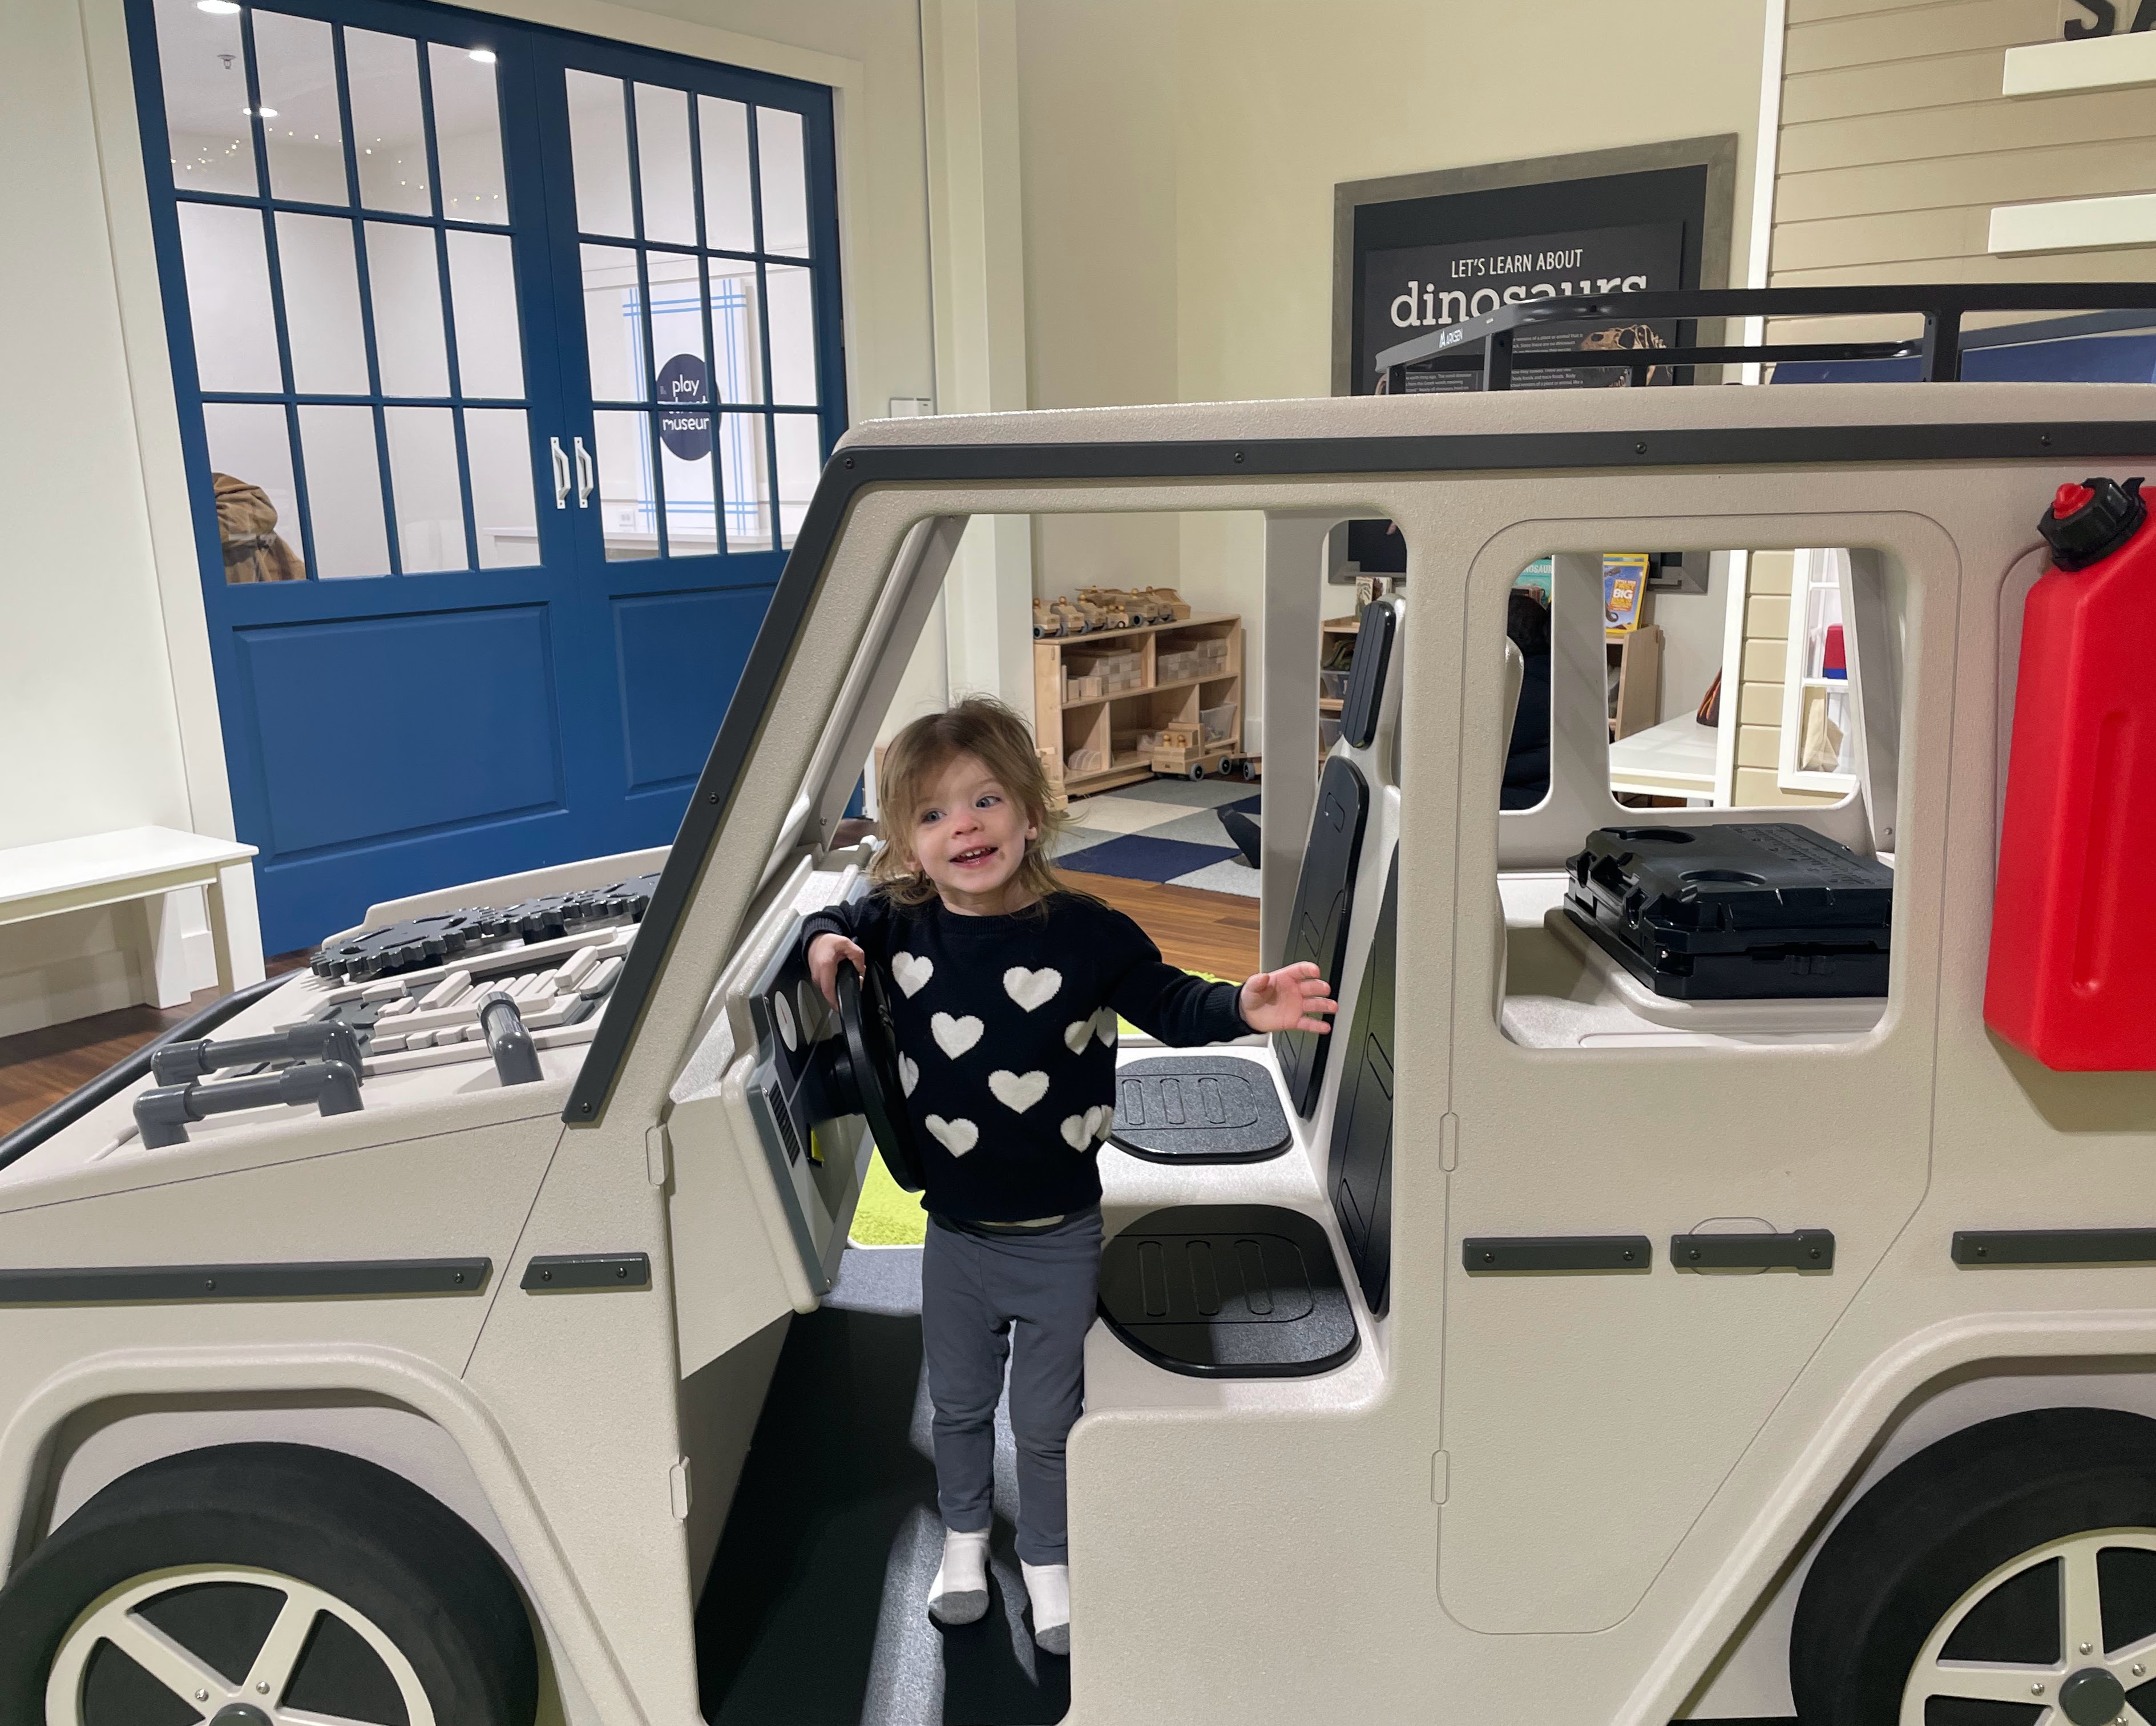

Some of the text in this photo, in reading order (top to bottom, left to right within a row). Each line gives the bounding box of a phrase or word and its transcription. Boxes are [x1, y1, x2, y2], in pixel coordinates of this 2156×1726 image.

[1451, 249, 1584, 278] LET'S LEARN ABOUT
[672, 374, 700, 397] play
[1613, 588, 1633, 599] BIG
